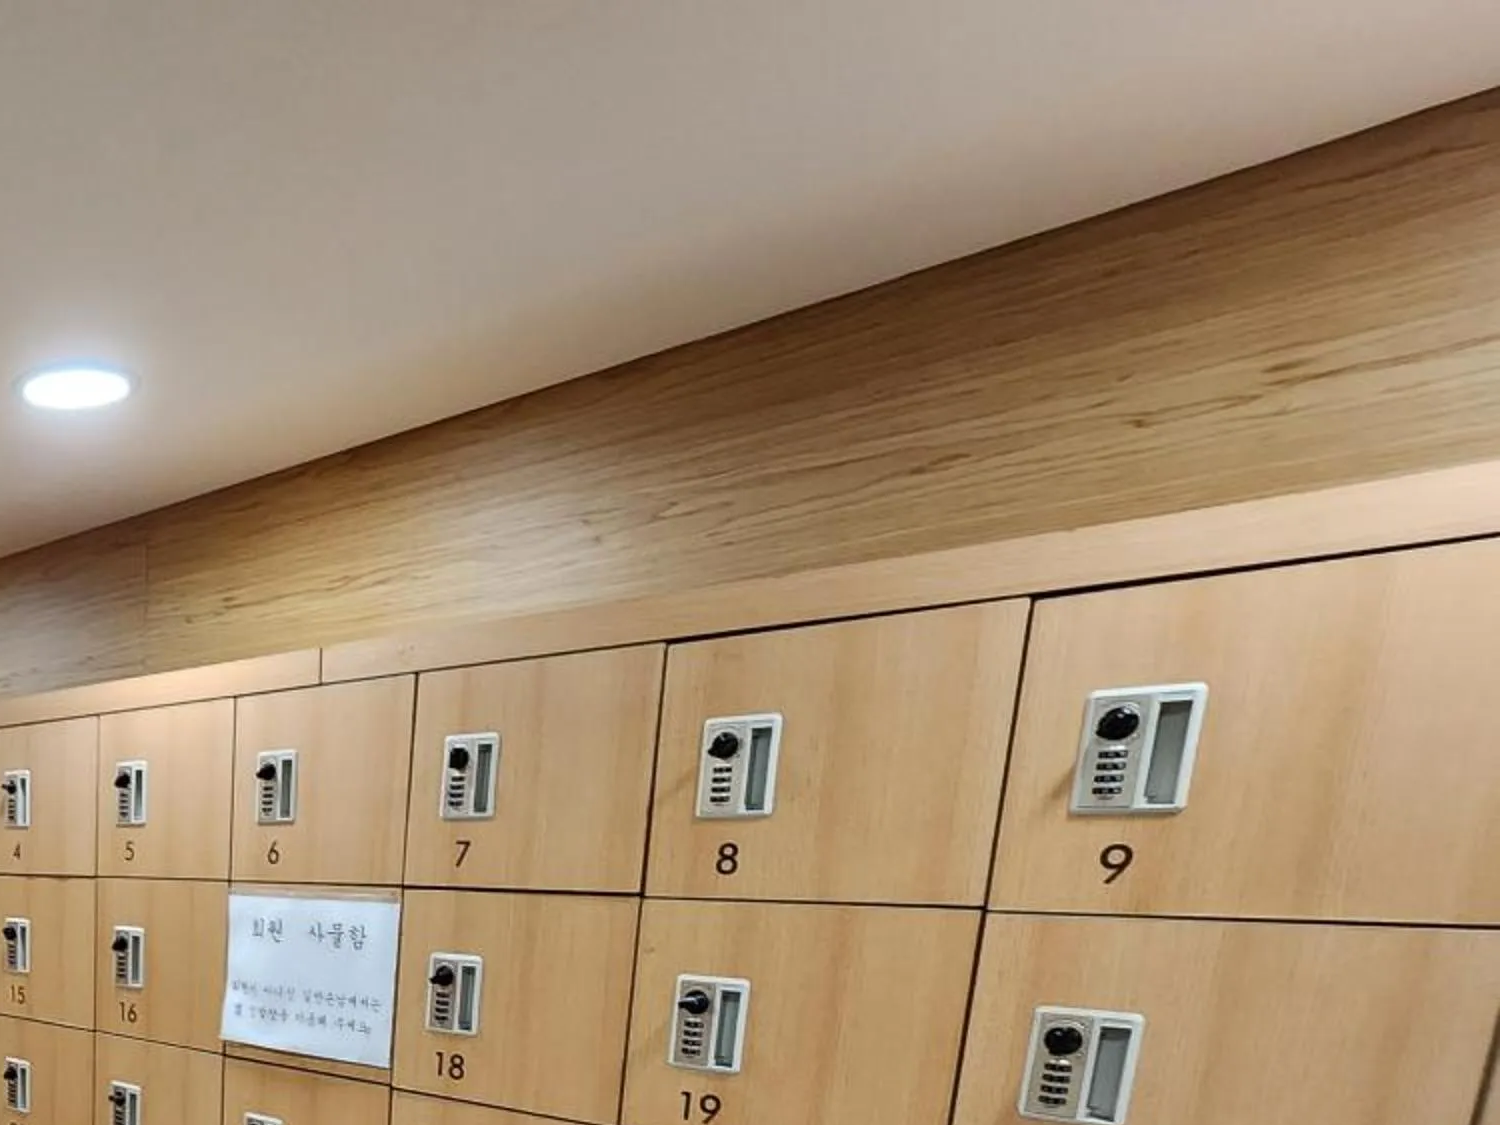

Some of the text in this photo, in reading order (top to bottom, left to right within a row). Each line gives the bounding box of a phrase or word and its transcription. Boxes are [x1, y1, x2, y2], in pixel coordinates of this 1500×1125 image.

[124, 841, 135, 862] 5
[267, 841, 280, 865] 6
[455, 840, 471, 868] 7
[716, 842, 739, 876] 8
[1099, 843, 1134, 885] 9
[252, 917, 367, 950] 회원 사물함
[119, 1001, 137, 1023] 16
[435, 1051, 465, 1081] 18
[679, 1090, 722, 1125] 19
